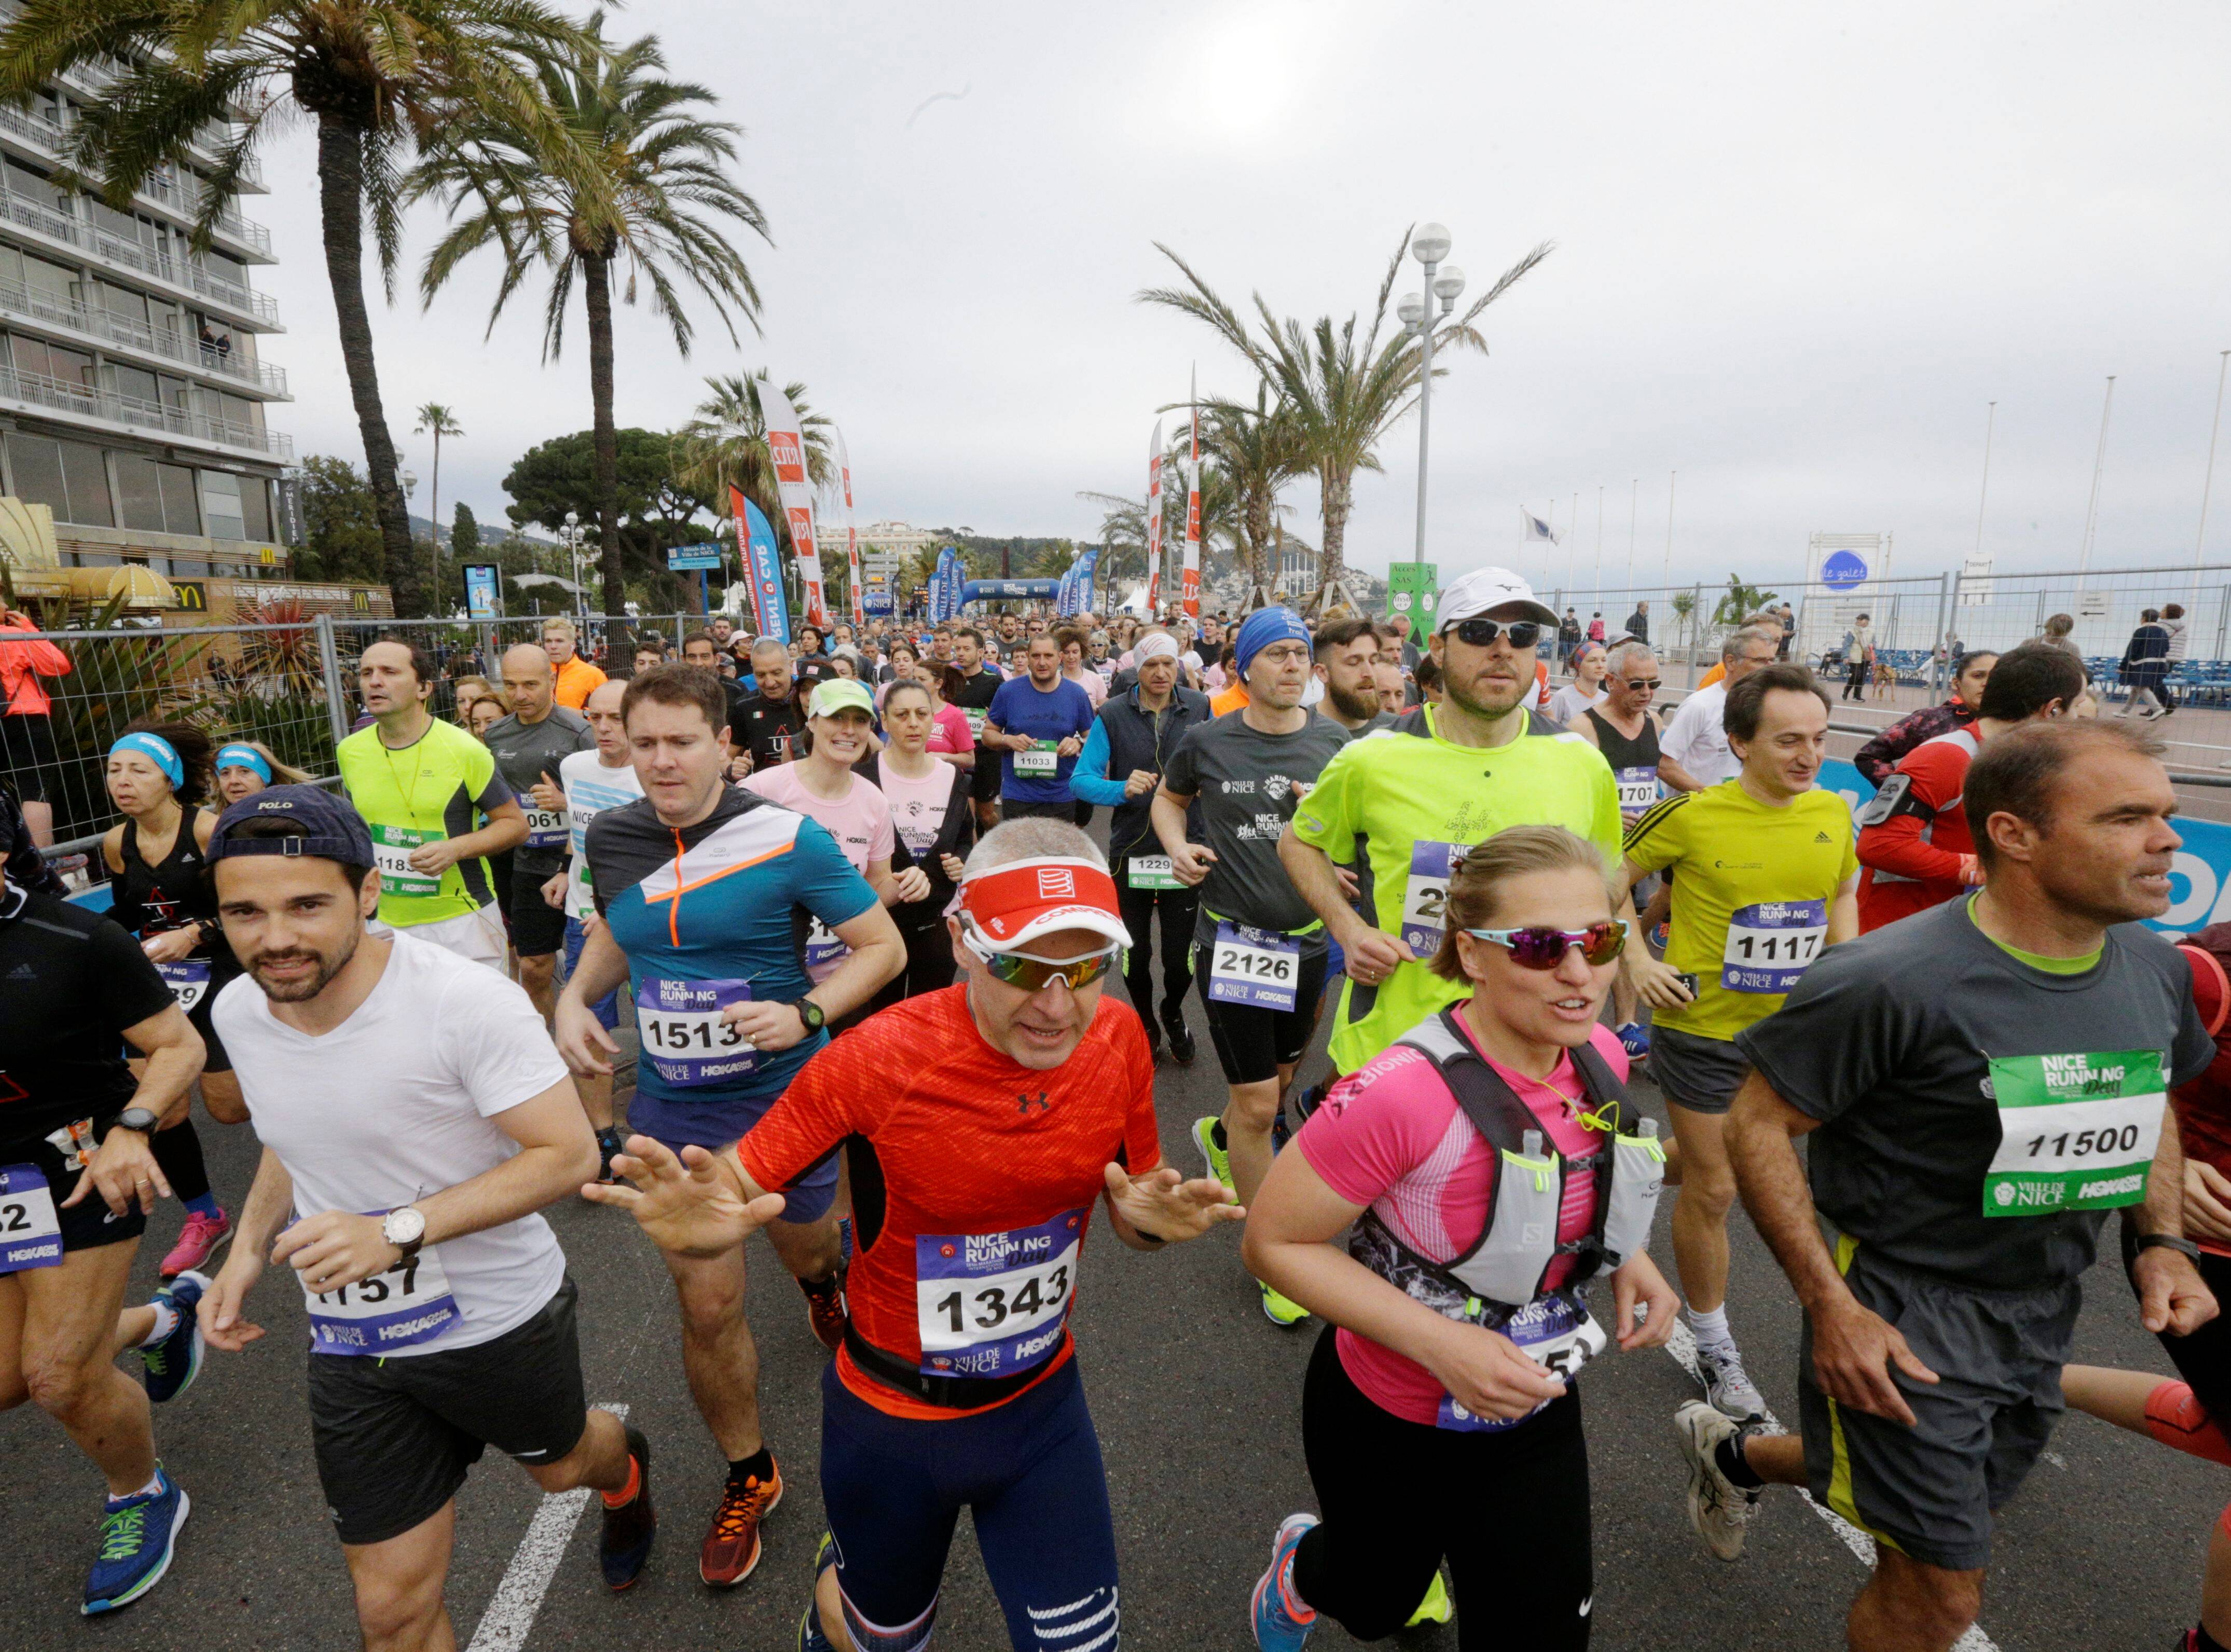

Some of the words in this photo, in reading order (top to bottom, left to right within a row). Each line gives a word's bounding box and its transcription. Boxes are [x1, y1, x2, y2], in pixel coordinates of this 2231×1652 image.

[1824, 568, 1834, 577] le
[1838, 567, 1865, 580] galet
[941, 581, 947, 592] DE
[940, 594, 948, 618] VILLE
[1289, 627, 1303, 636] trail
[1264, 775, 1290, 786] HARIBO
[1619, 788, 1652, 801] 1707
[258, 801, 293, 810] POLO
[1255, 814, 1279, 822] NICE
[385, 826, 403, 834] NICE
[916, 837, 933, 845] Day
[1449, 845, 1473, 856] NIC
[1138, 860, 1173, 869] 1229
[1240, 925, 1261, 936] NICE
[1738, 935, 1817, 960] 1117
[1220, 950, 1290, 980] 2126
[660, 980, 685, 991] NICE
[1742, 978, 1771, 988] NICE
[1781, 976, 1800, 986] HO
[1225, 989, 1248, 999] NICE
[1255, 990, 1282, 1002] HOKA
[684, 998, 716, 1011] Day
[649, 1020, 742, 1049] 1513
[2041, 1054, 2087, 1071] NICE
[661, 1070, 690, 1080] NICE
[701, 1064, 738, 1077] HOKA
[2045, 1066, 2125, 1087] RUNNING
[2083, 1080, 2120, 1097] Day
[2028, 1125, 2138, 1157] 11500
[2018, 1182, 2048, 1192] VILLE
[2050, 1182, 2065, 1192] DE
[2018, 1192, 2065, 1206] NICE
[965, 1232, 1009, 1249] NICE
[8, 1248, 44, 1262] HOKA
[1006, 1249, 1048, 1266] Day
[319, 1256, 420, 1305] 57
[938, 1265, 1068, 1332] 1343
[378, 1316, 429, 1341] HOKA
[337, 1332, 368, 1346] NICE
[955, 1352, 984, 1365] VILLE
[986, 1347, 1000, 1357] DE
[955, 1357, 1000, 1373] NICE
